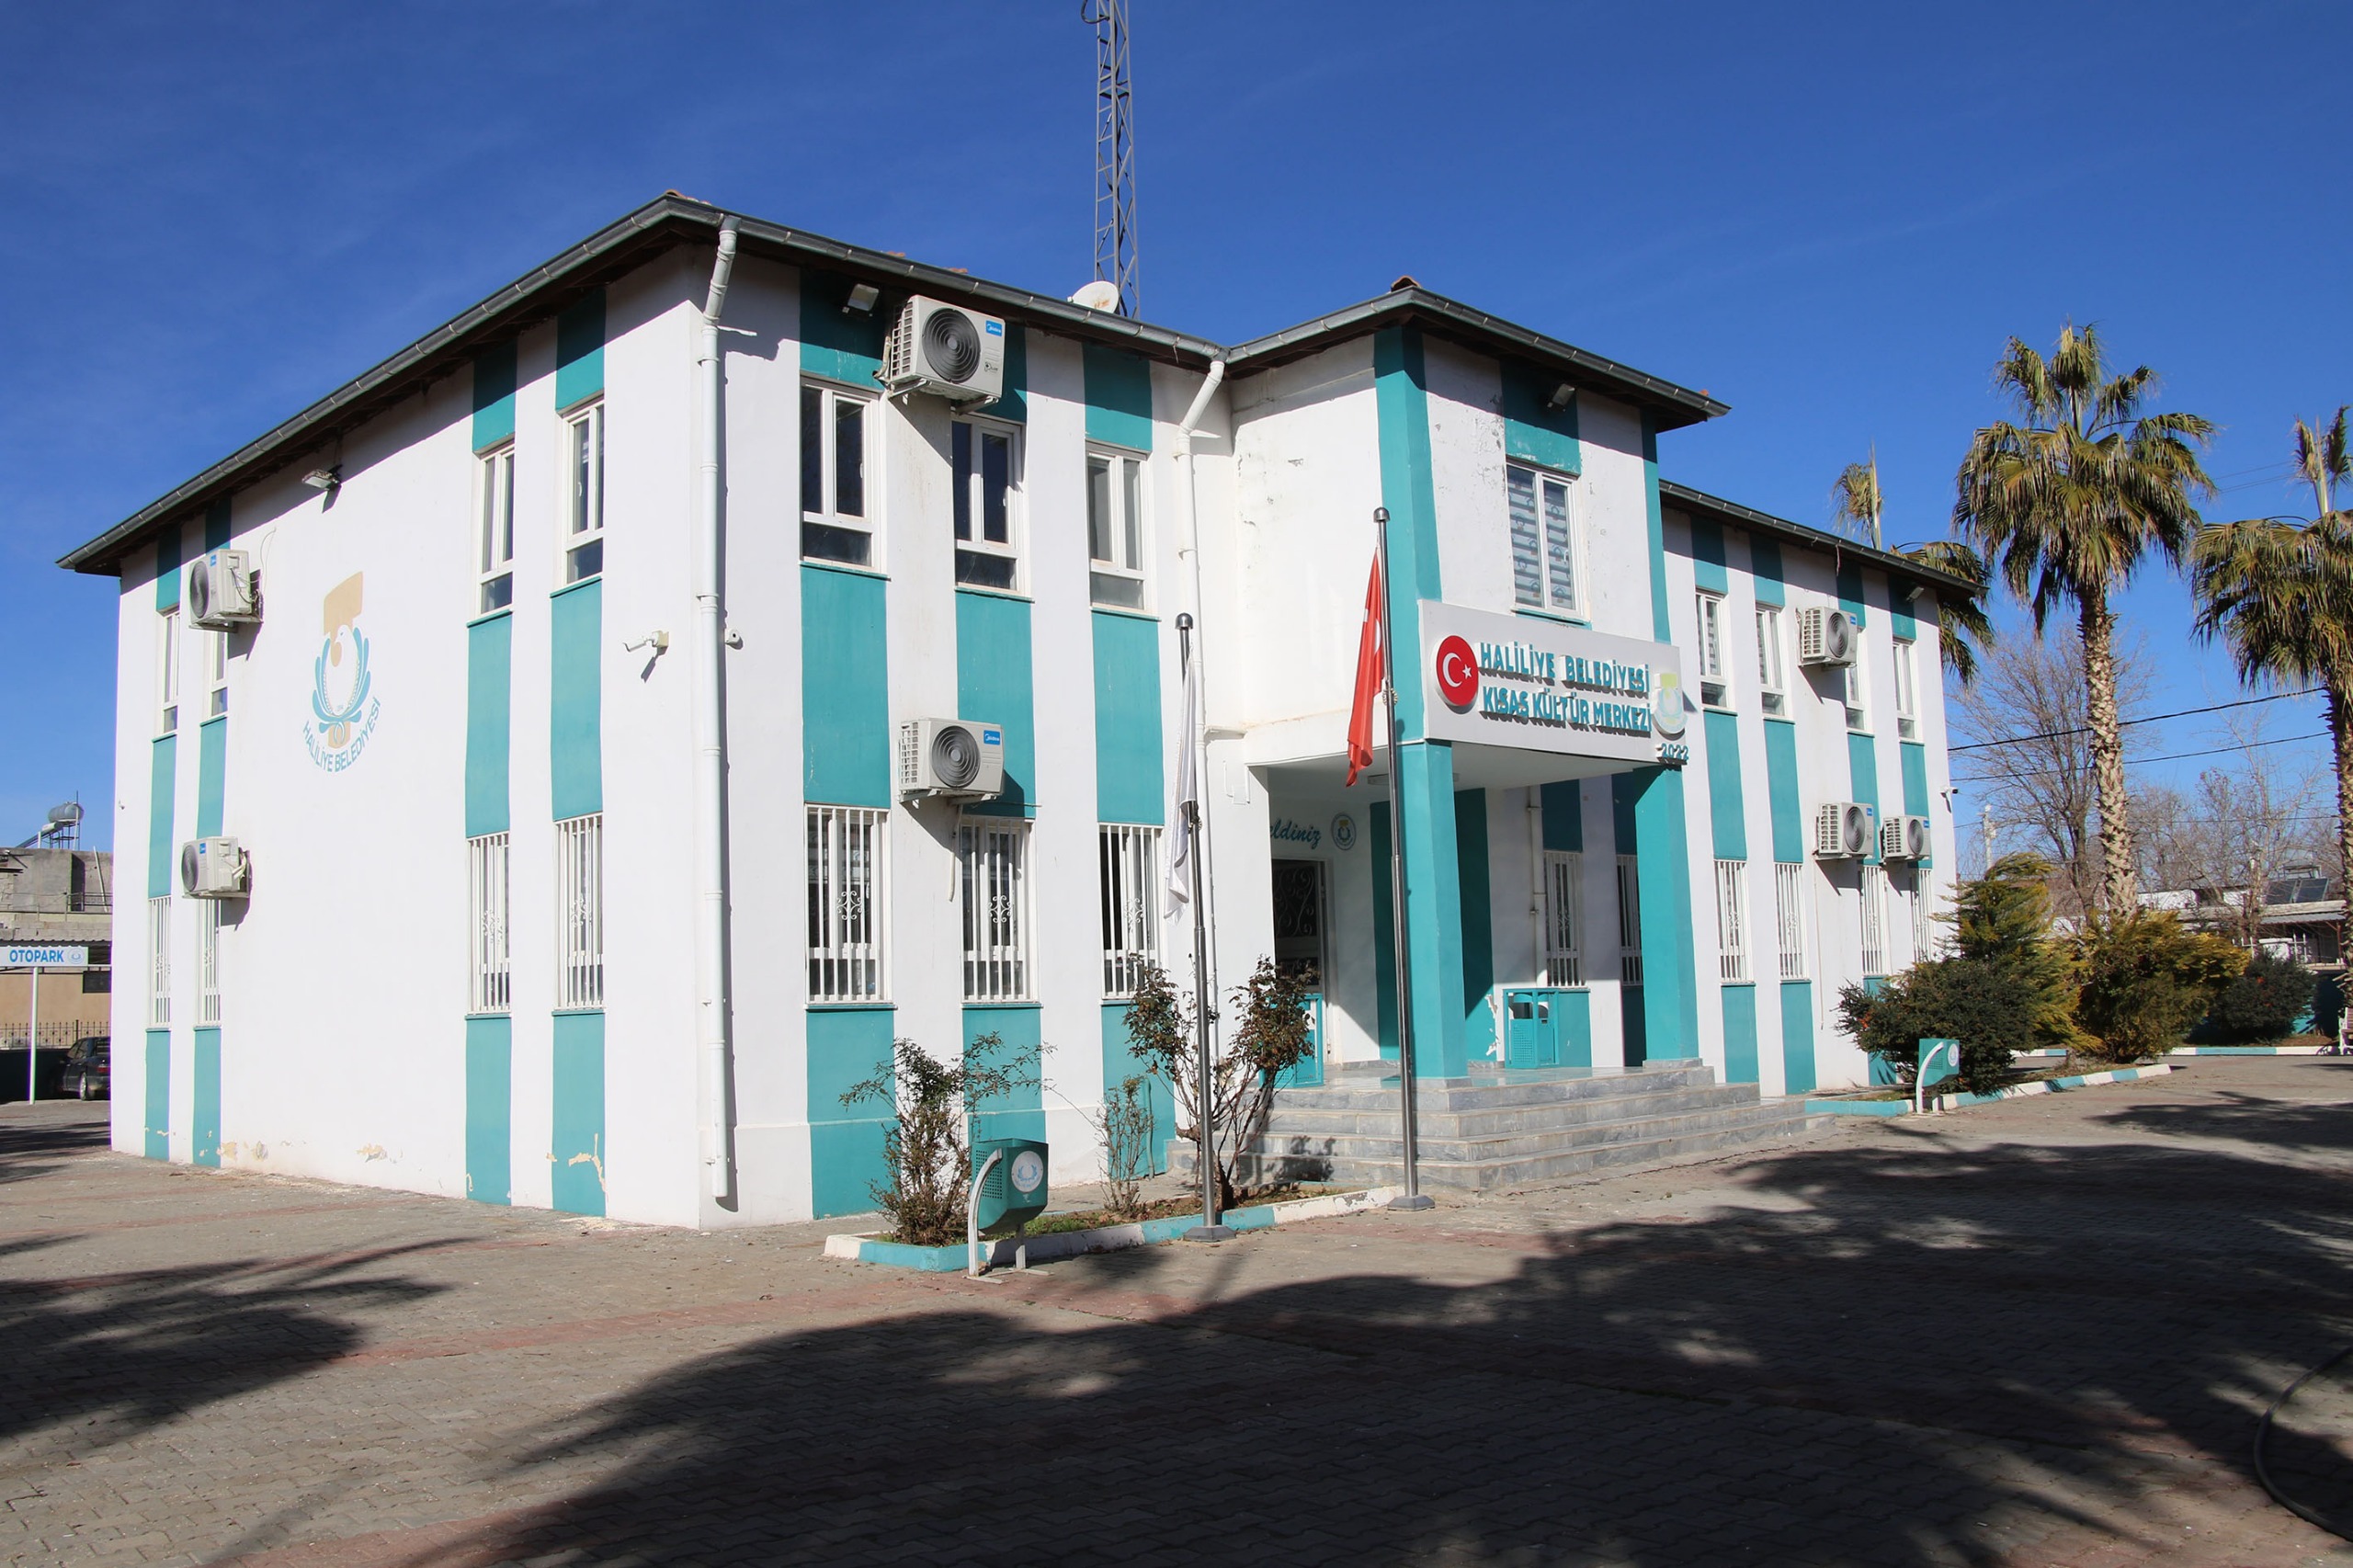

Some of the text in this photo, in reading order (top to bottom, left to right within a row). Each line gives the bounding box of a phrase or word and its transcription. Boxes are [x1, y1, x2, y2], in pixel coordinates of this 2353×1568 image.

[1481, 642, 1650, 692] HALİLİYE BELEDİYESİ
[1483, 686, 1529, 717] KISAS
[1532, 687, 1590, 725] KÜLTÜR
[1593, 701, 1652, 732] MERKEZİ
[1661, 743, 1688, 761] 2022
[9, 949, 64, 962] OTOPARK
